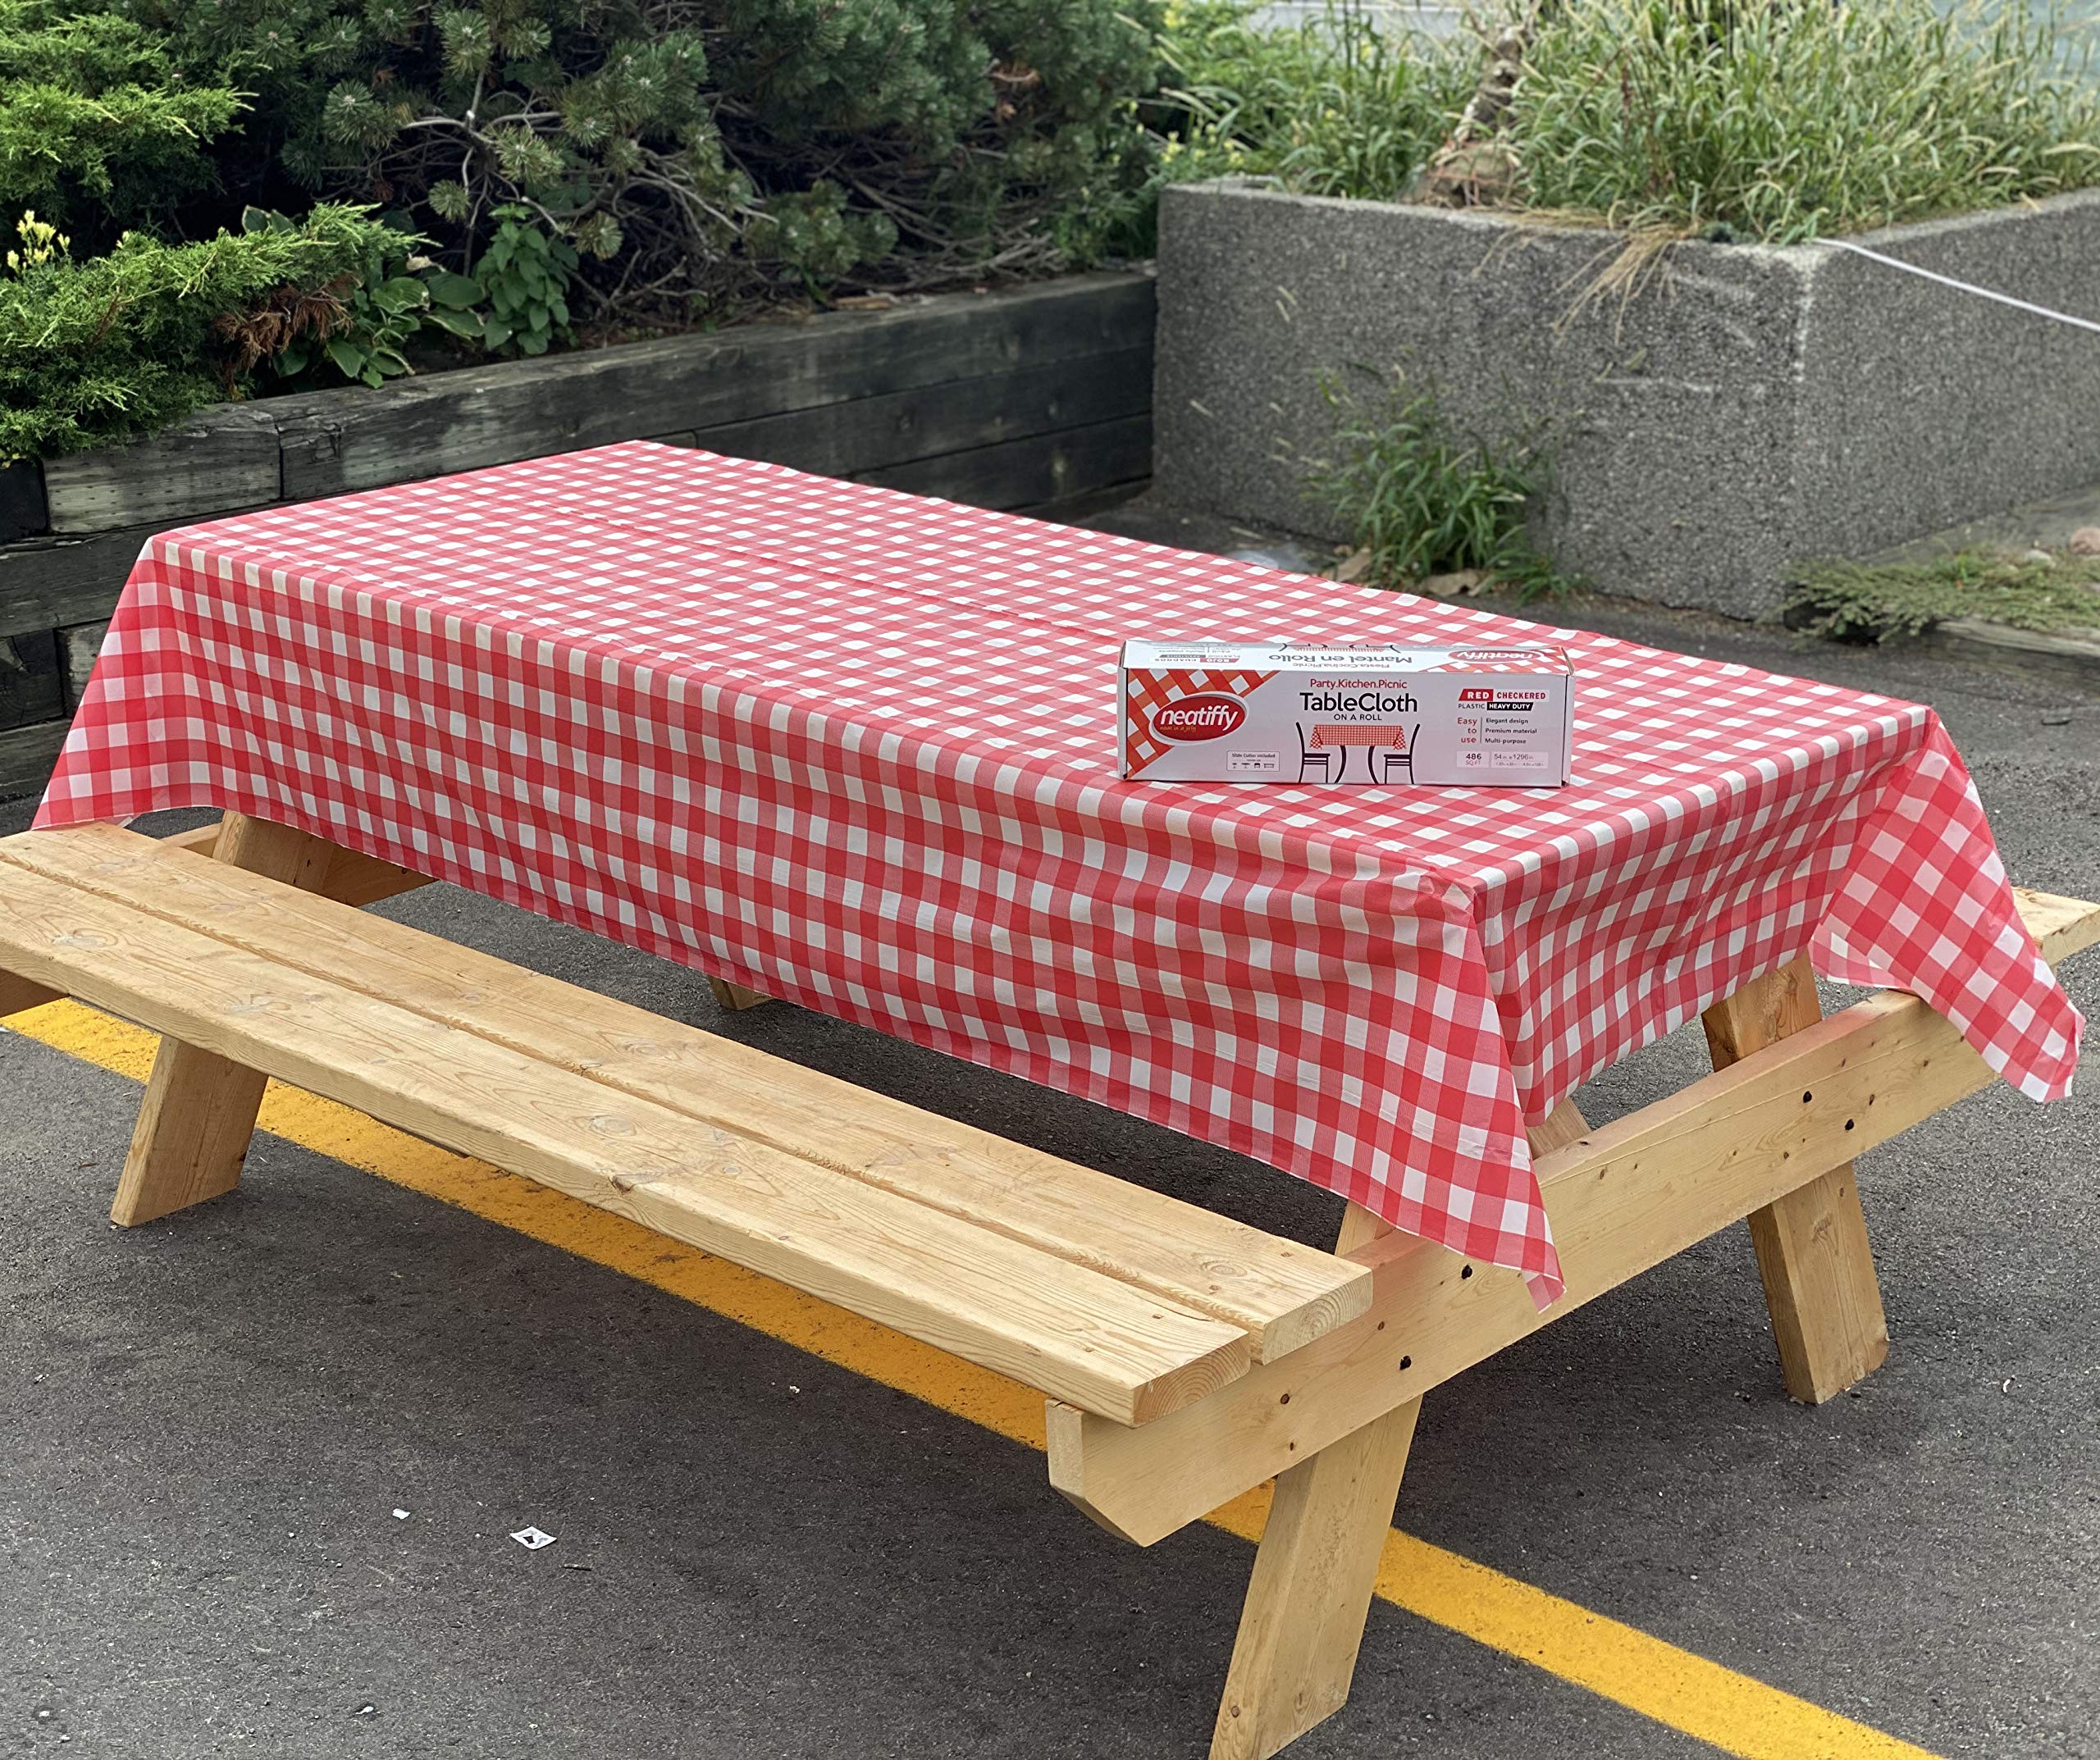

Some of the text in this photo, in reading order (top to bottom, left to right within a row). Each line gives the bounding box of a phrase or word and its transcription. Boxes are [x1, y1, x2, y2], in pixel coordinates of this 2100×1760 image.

[1350, 655, 1413, 663] Mantel
[1309, 678, 1408, 690] Party.Kitchen.Picnic
[1467, 691, 1546, 700] RED CHECKERED
[1299, 691, 1418, 712] TableCloth
[1160, 704, 1239, 732] neatiffy
[1457, 717, 1477, 726] Easy
